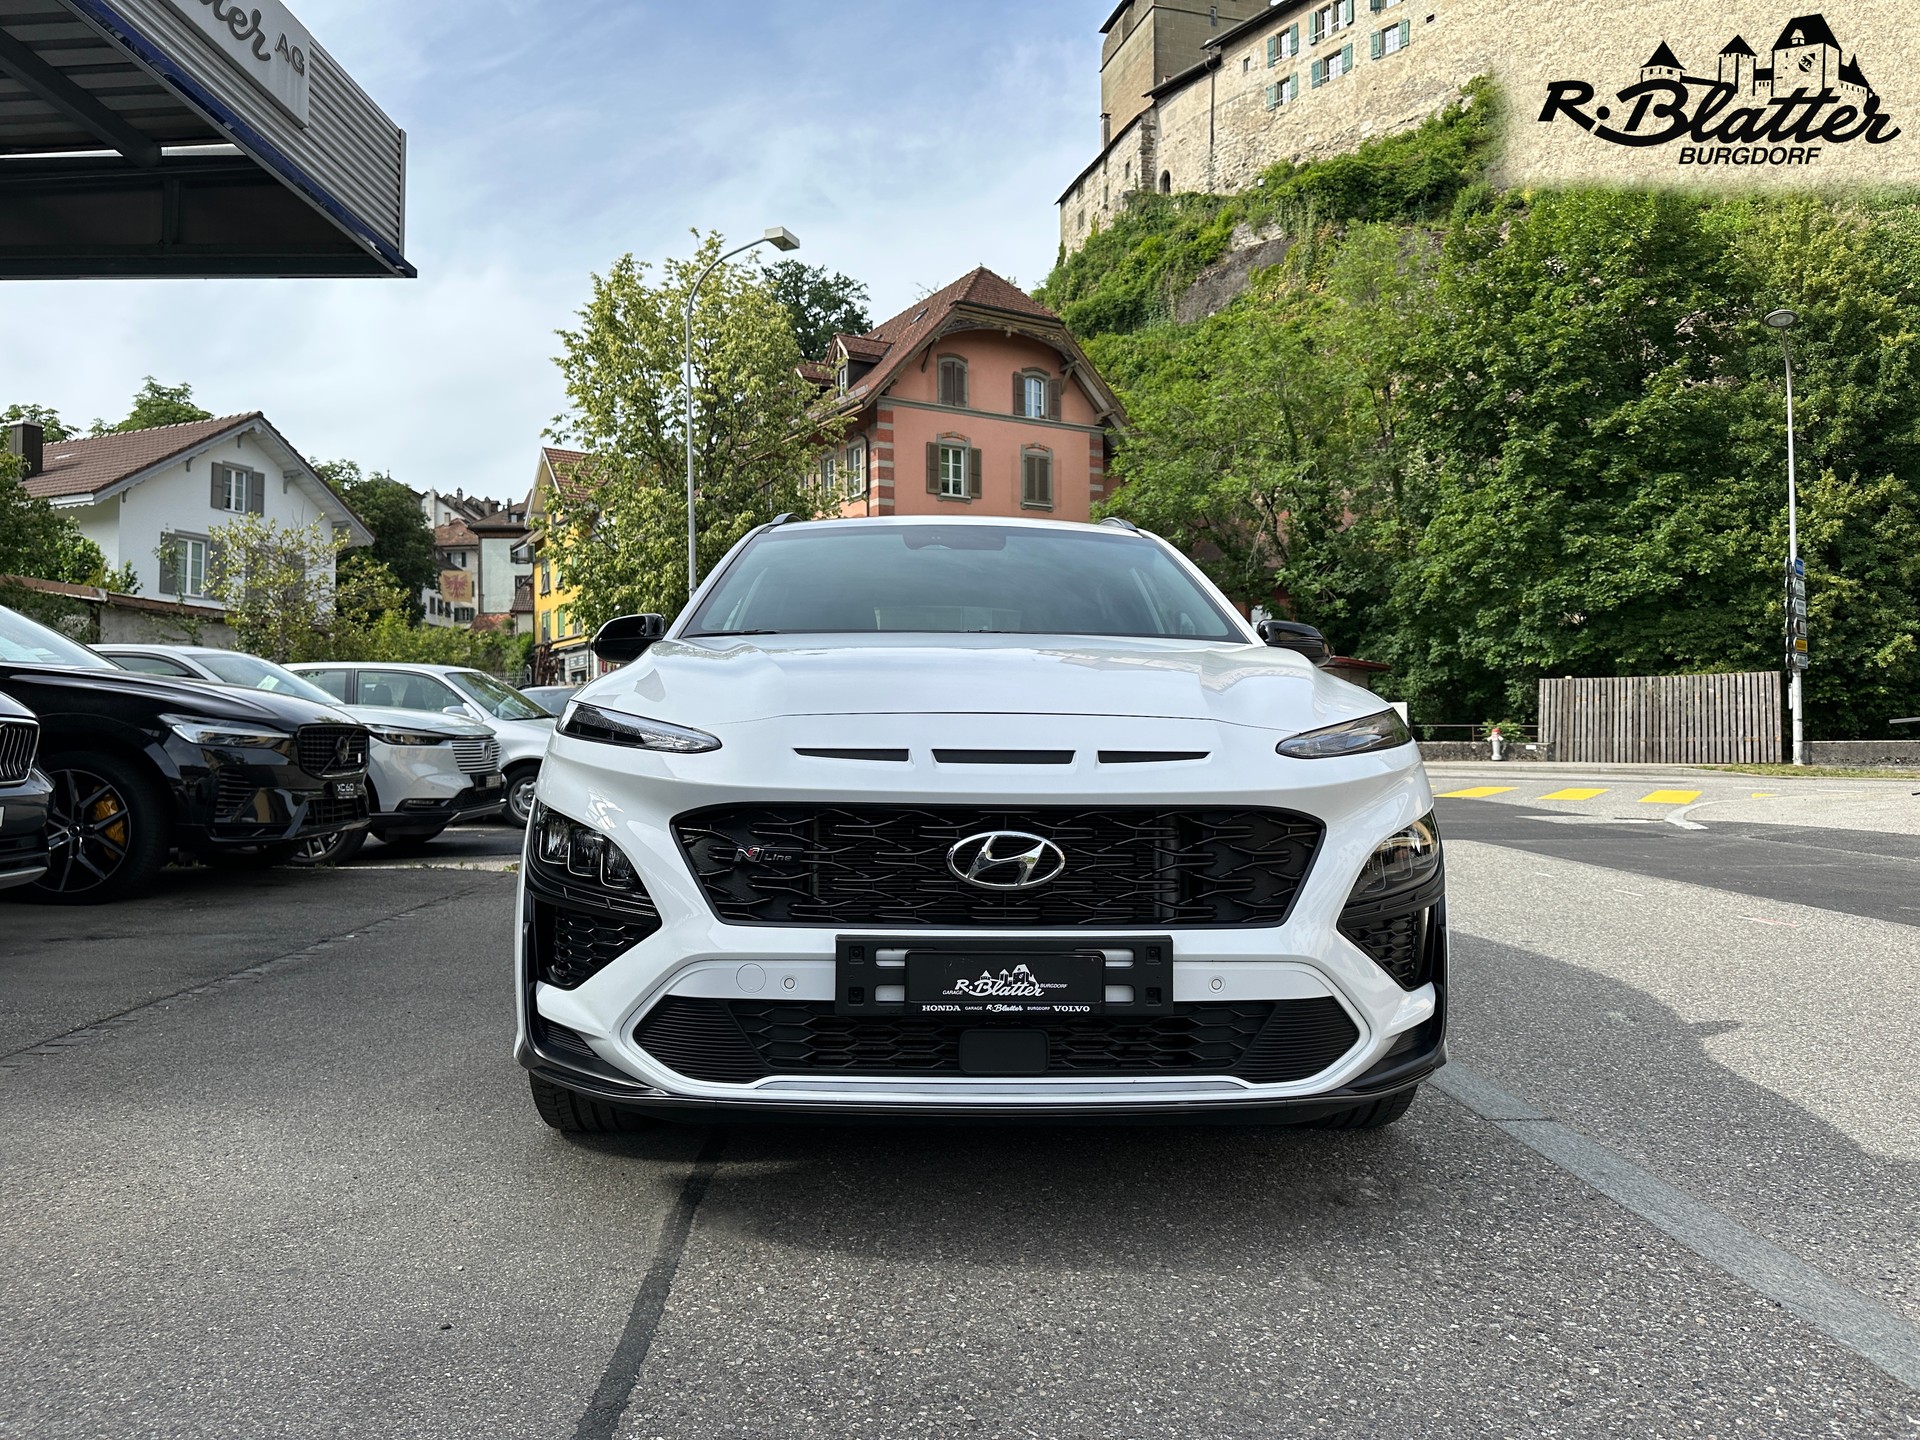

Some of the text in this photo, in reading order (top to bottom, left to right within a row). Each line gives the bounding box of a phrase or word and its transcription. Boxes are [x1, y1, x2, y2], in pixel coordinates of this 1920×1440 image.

[274, 32, 305, 77] AG
[336, 783, 354, 791] XC60
[764, 853, 792, 861] Line
[921, 1004, 962, 1012] HONDA
[1052, 1005, 1091, 1013] VOLVO
